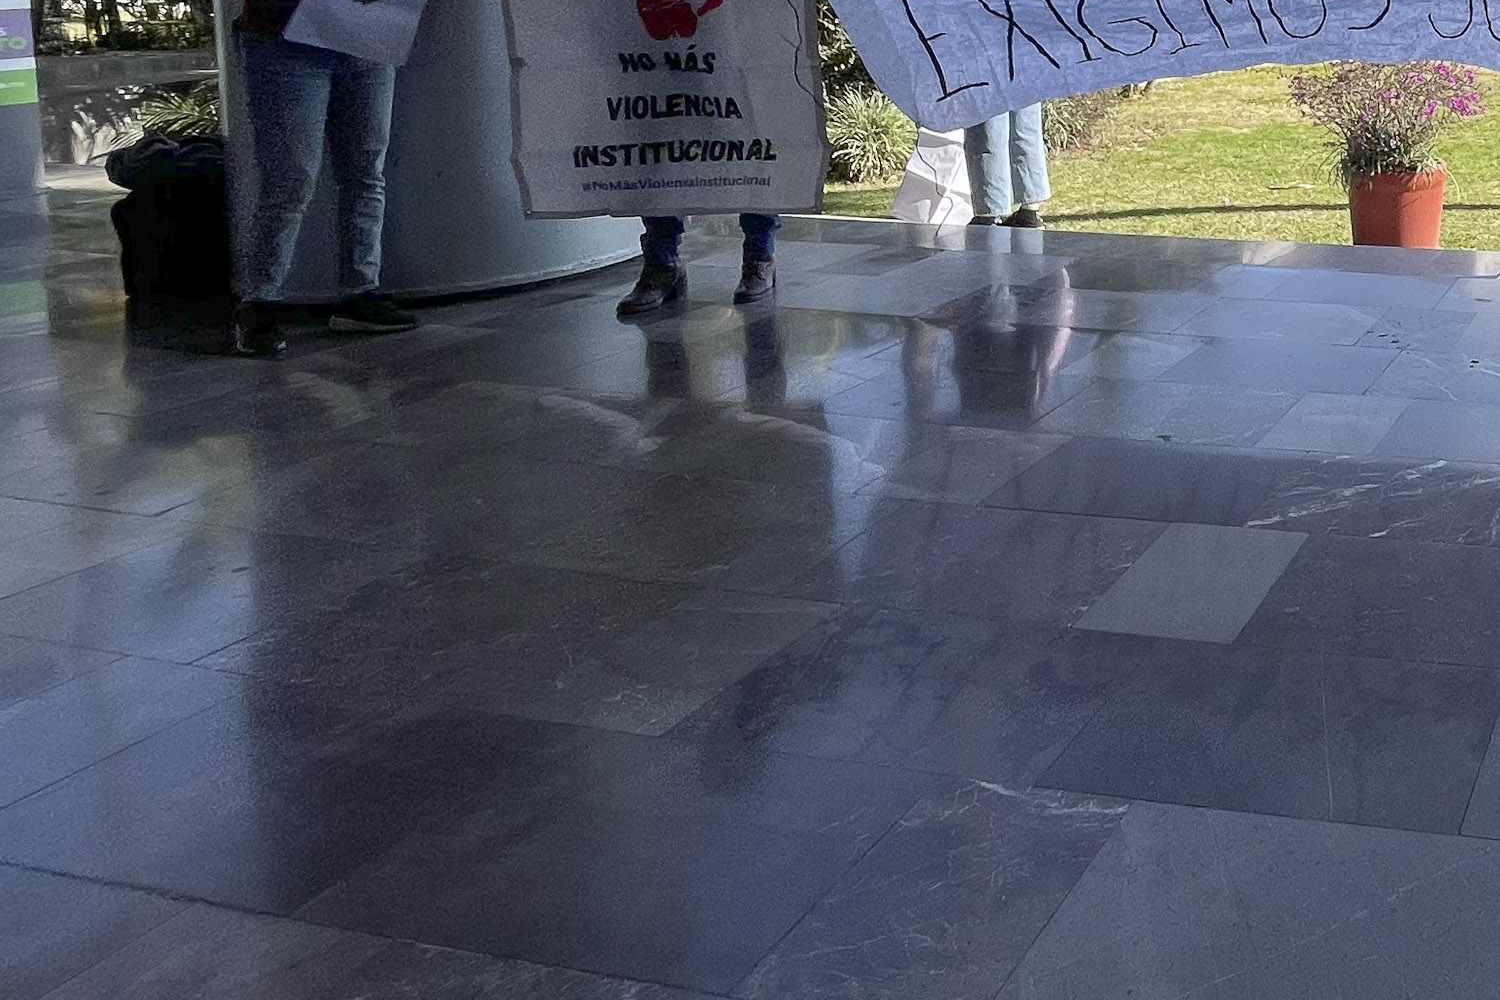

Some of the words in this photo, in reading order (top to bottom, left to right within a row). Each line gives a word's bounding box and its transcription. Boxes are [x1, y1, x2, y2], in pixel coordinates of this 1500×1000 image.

[618, 52, 657, 73] NO
[664, 44, 716, 75] MÁS
[606, 93, 743, 121] VIOLENCIA
[572, 138, 777, 168] INSTITUCIONAL
